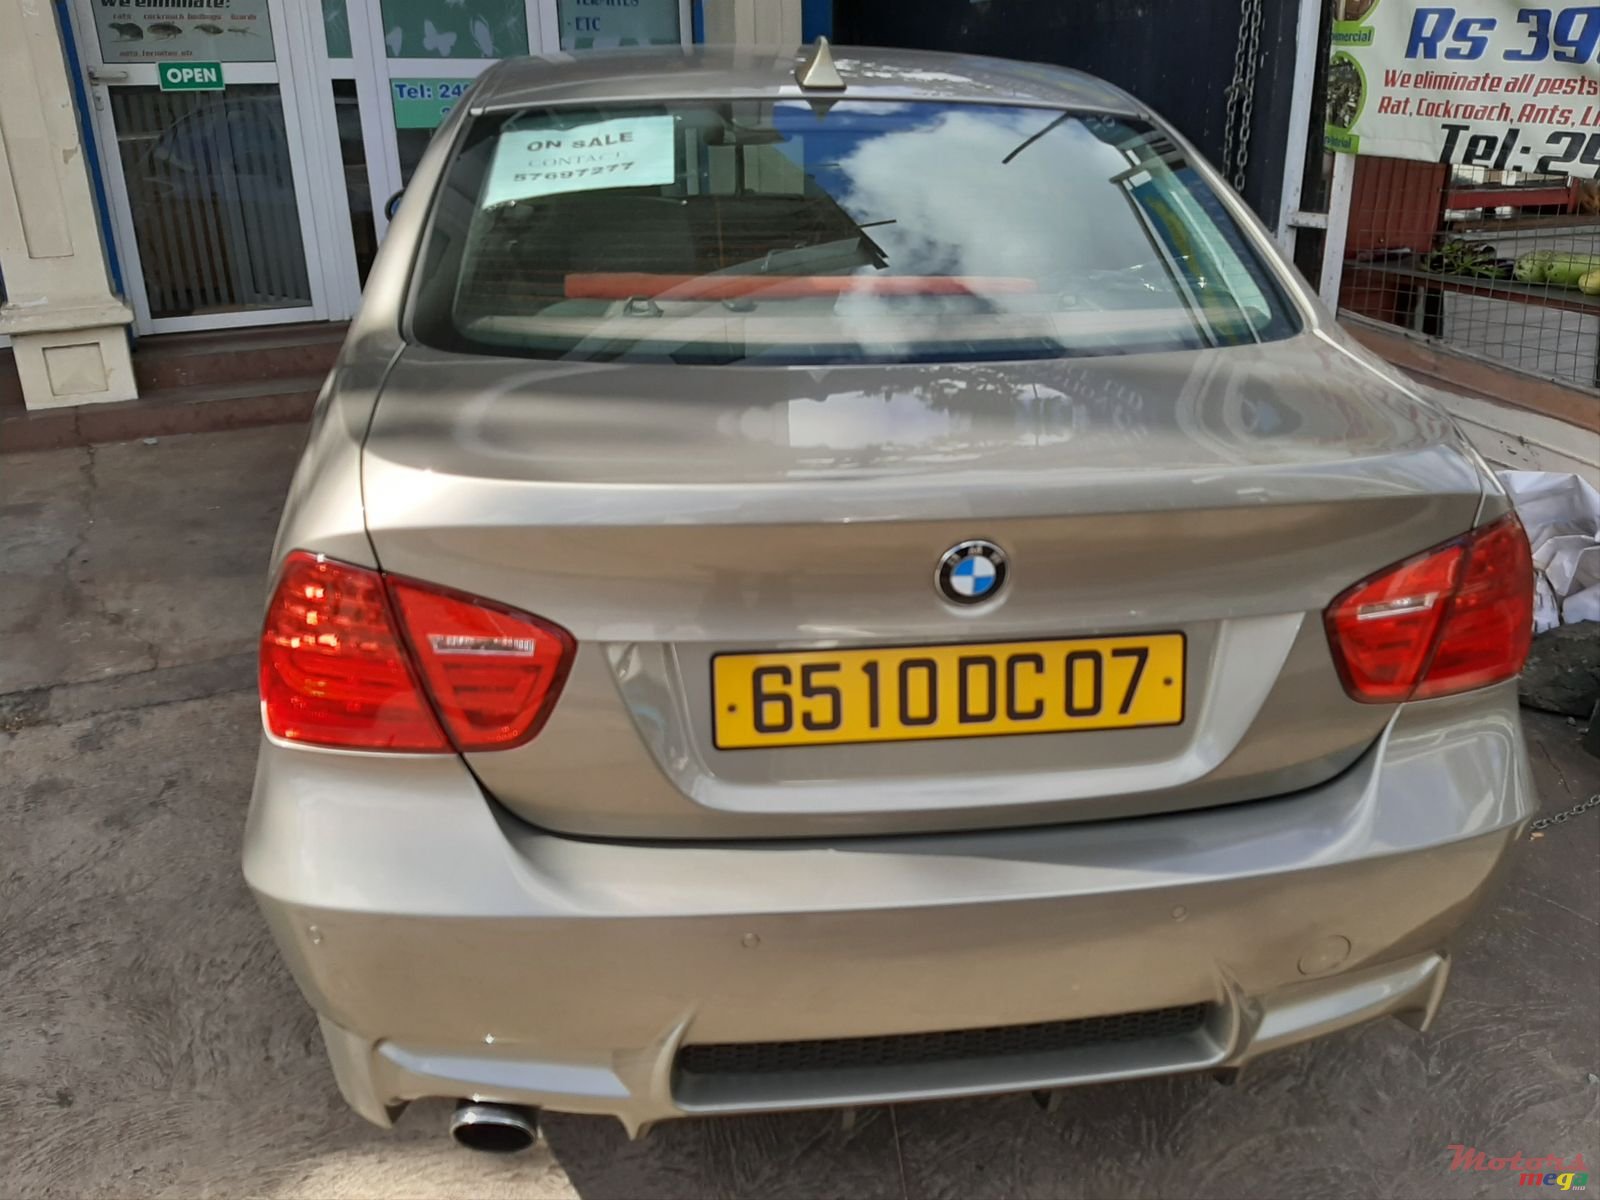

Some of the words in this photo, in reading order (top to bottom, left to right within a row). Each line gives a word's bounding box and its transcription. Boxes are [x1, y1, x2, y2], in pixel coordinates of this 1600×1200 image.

[575, 16, 601, 31] ETC
[1404, 7, 1497, 61] Rs
[1502, 6, 1600, 65] 39
[166, 67, 217, 84] OPEN
[1384, 69, 1411, 89] We
[1414, 71, 1504, 93] eliminate
[1504, 73, 1536, 93] all
[1532, 75, 1600, 97] pests
[394, 84, 432, 99] Tel:
[1377, 96, 1413, 117] Rat,
[1416, 98, 1514, 125] Cockroach,
[1517, 103, 1576, 129] Ants,
[526, 140, 561, 152] ON
[572, 131, 634, 149] SALE
[1440, 124, 1532, 173] Tel:
[528, 151, 629, 168] CONTACT
[751, 657, 938, 735] 6510
[958, 652, 1045, 725] DC
[1065, 646, 1149, 719] 07
